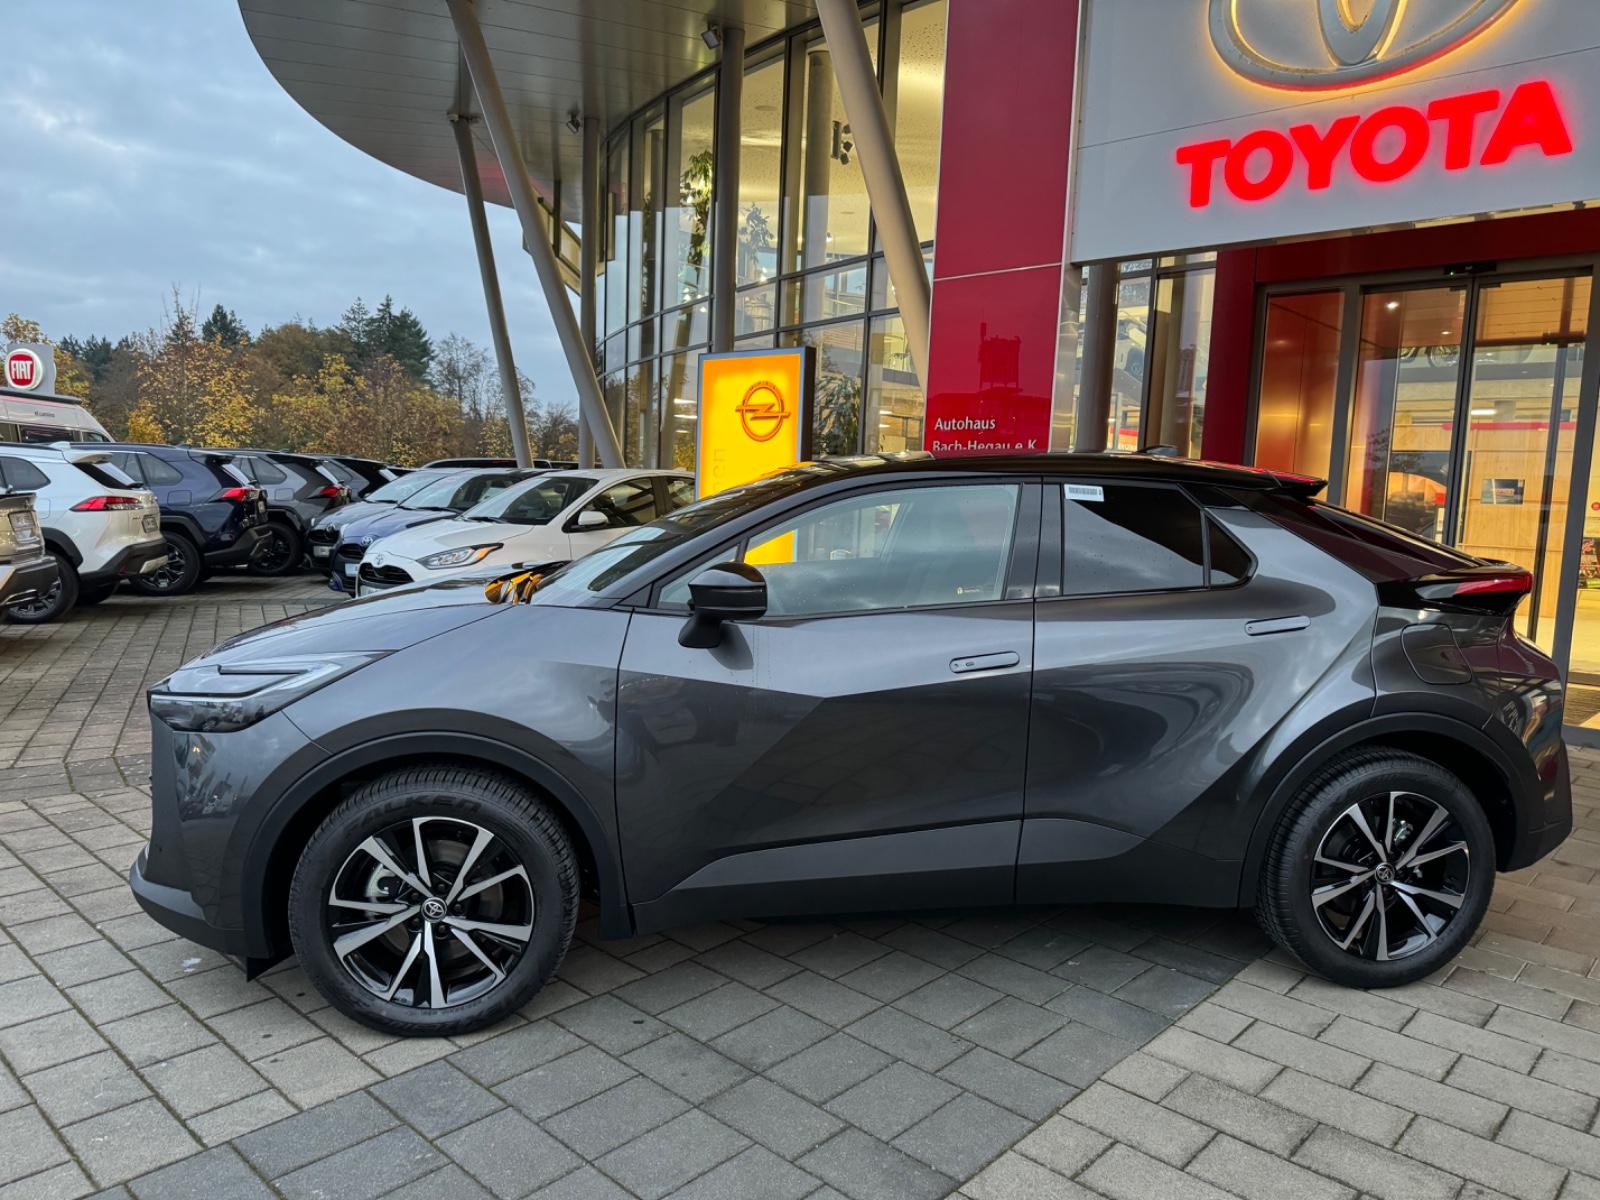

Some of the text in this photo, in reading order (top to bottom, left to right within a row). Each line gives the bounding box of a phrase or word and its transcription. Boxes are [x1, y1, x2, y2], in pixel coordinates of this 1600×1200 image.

[1177, 82, 1572, 207] TOYOTA
[10, 360, 33, 380] FIAT
[934, 416, 996, 431] Autohaus
